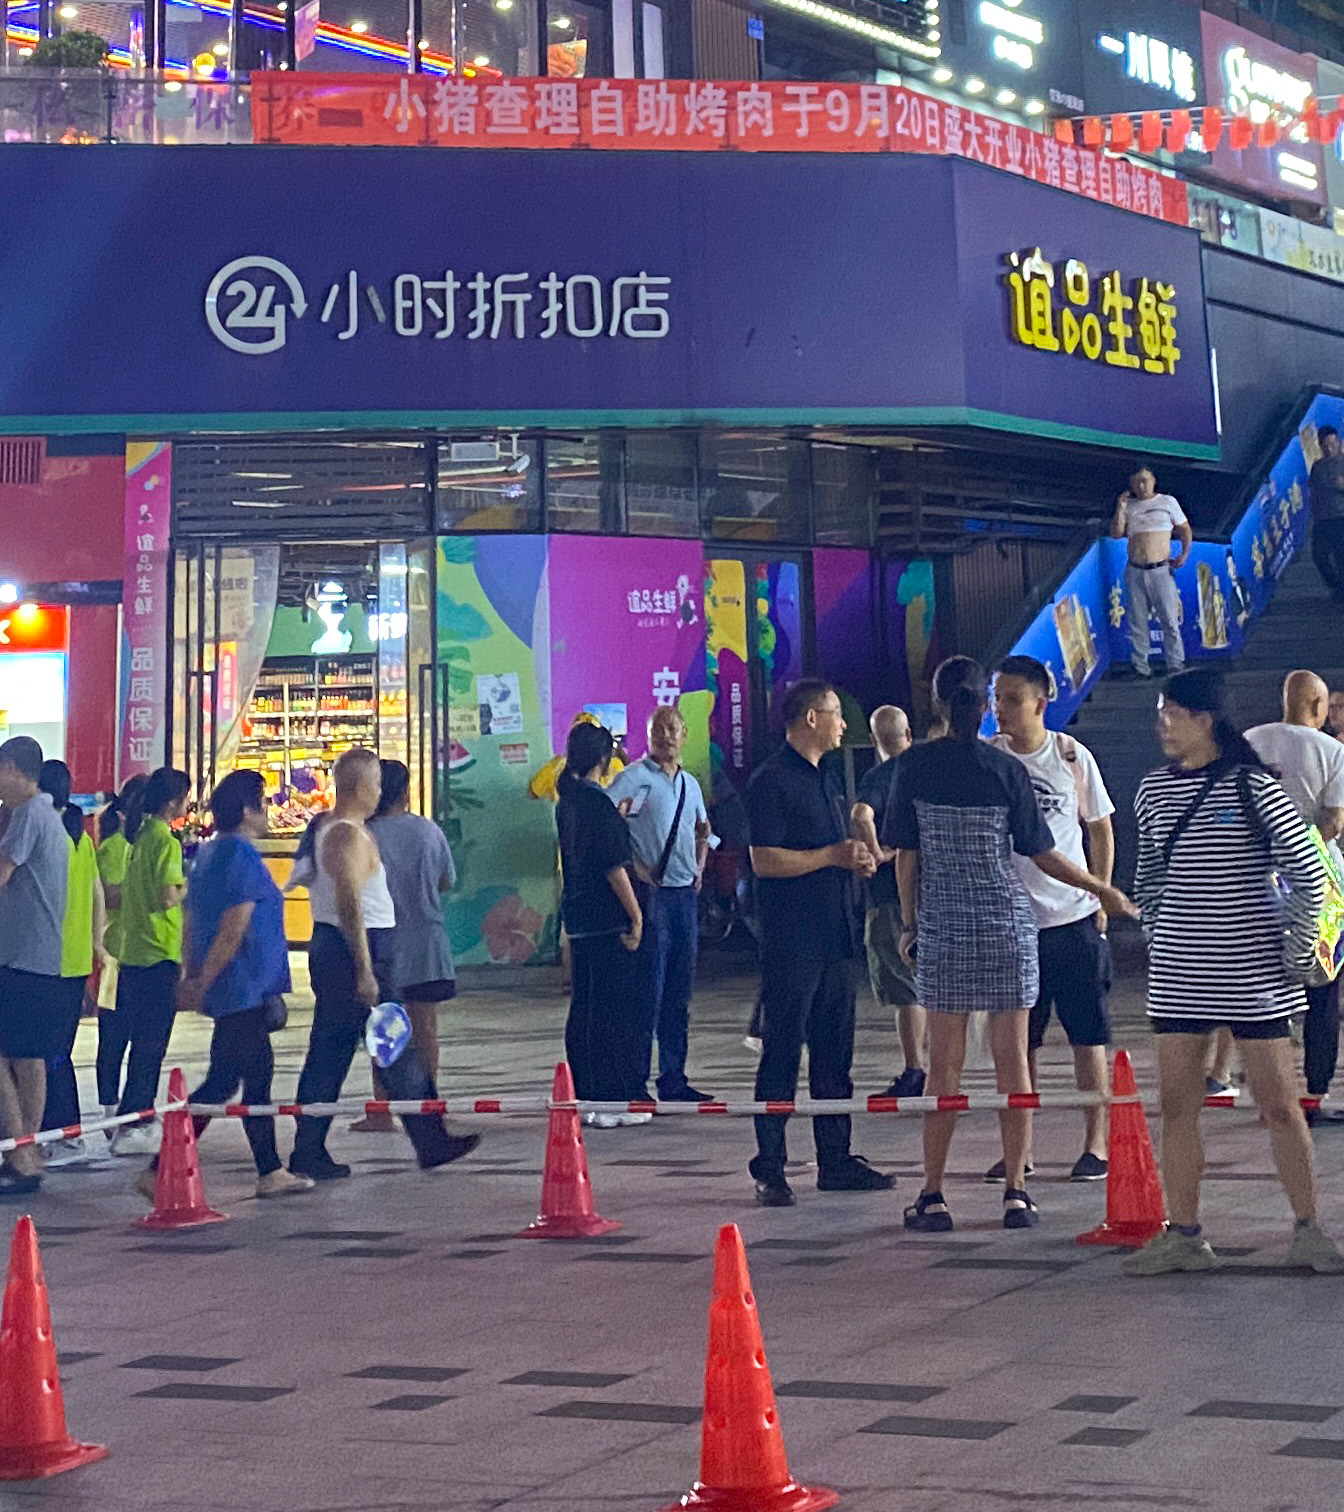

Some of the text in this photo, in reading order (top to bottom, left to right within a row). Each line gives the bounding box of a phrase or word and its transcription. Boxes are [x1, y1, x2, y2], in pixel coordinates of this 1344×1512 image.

[320, 269, 673, 341] 小时折扣店
[1006, 246, 1181, 376] 谊品生鲜
[128, 646, 156, 762] 品质保证
